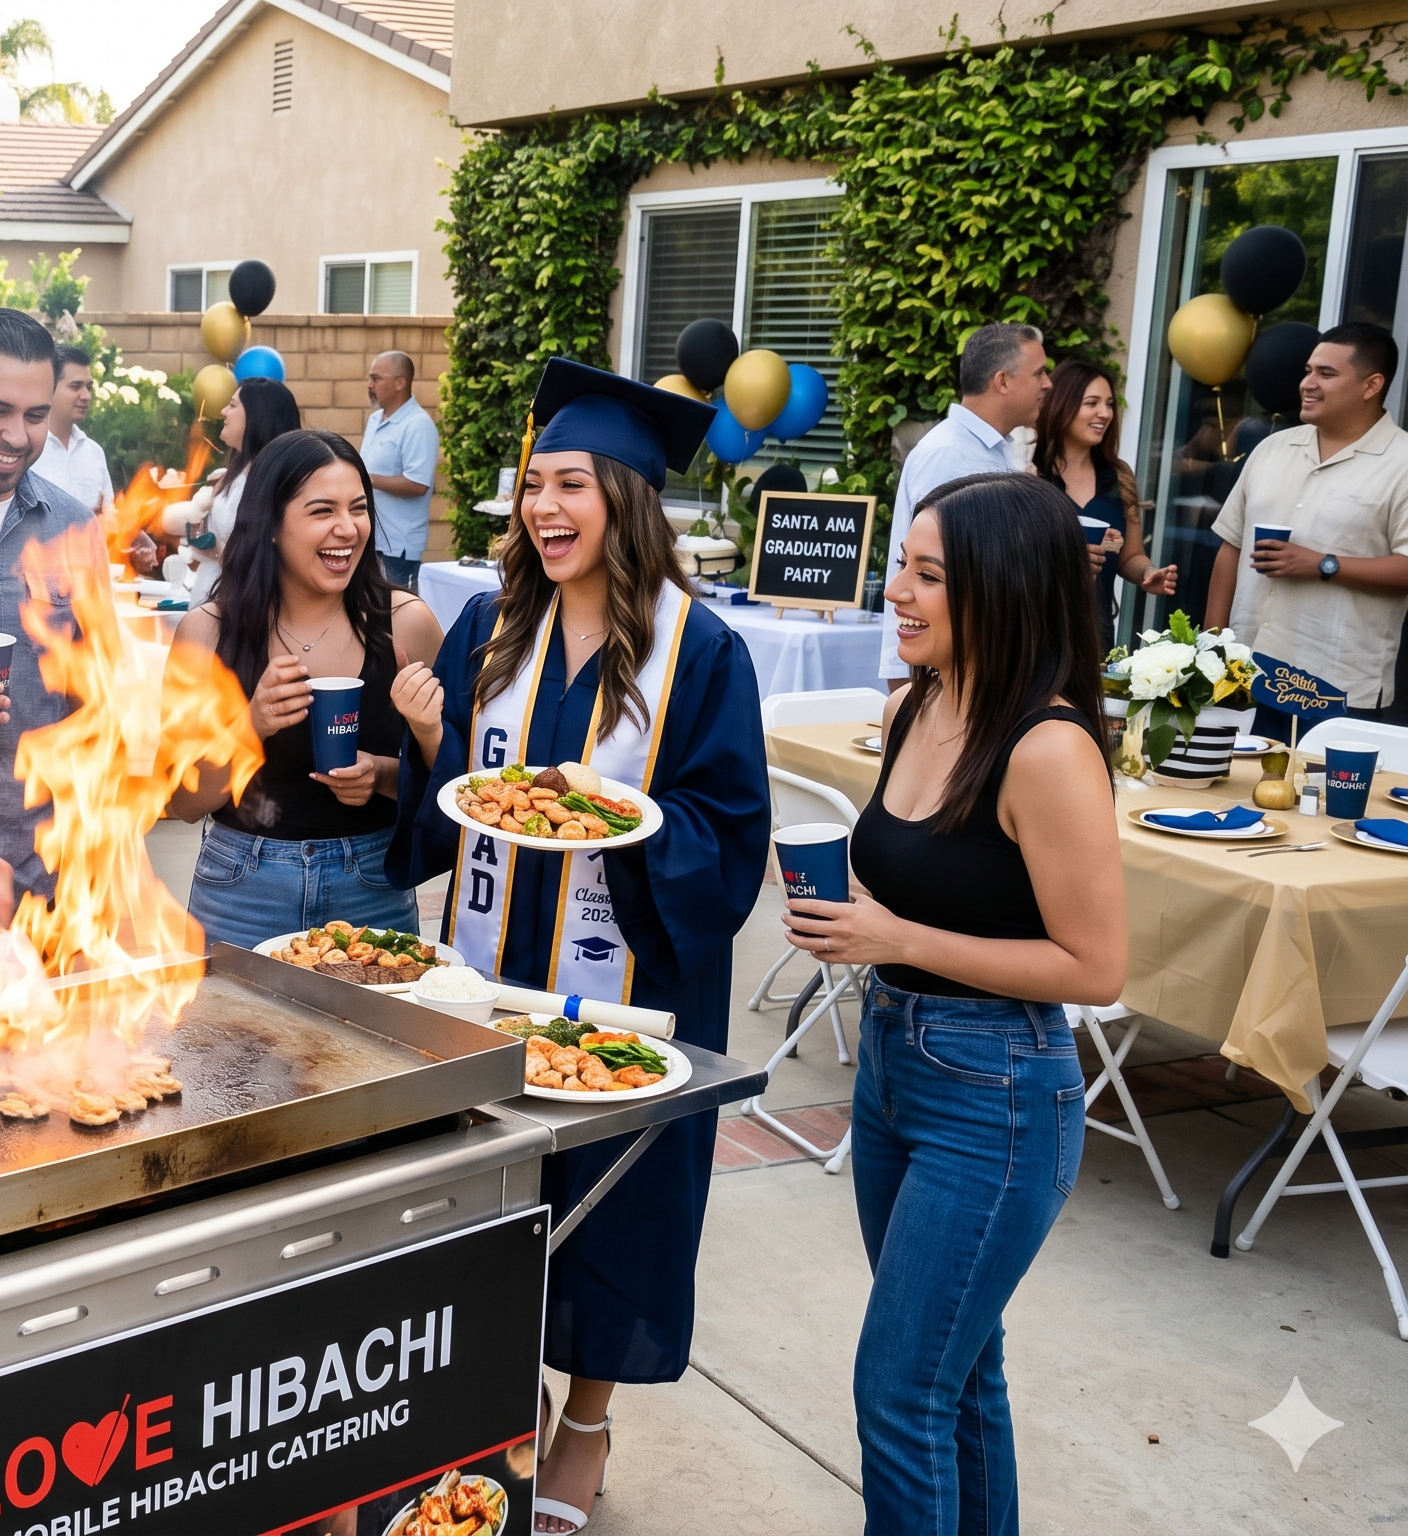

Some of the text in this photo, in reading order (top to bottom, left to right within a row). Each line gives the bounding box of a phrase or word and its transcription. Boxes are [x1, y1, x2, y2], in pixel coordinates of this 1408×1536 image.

[771, 513, 856, 533] SANTA ANA
[764, 539, 857, 560] GRADUATION
[783, 566, 832, 584] PARTY
[202, 1304, 454, 1448] HIBACHI
[13, 1399, 410, 1536] BILE HIBACHI CATERING
